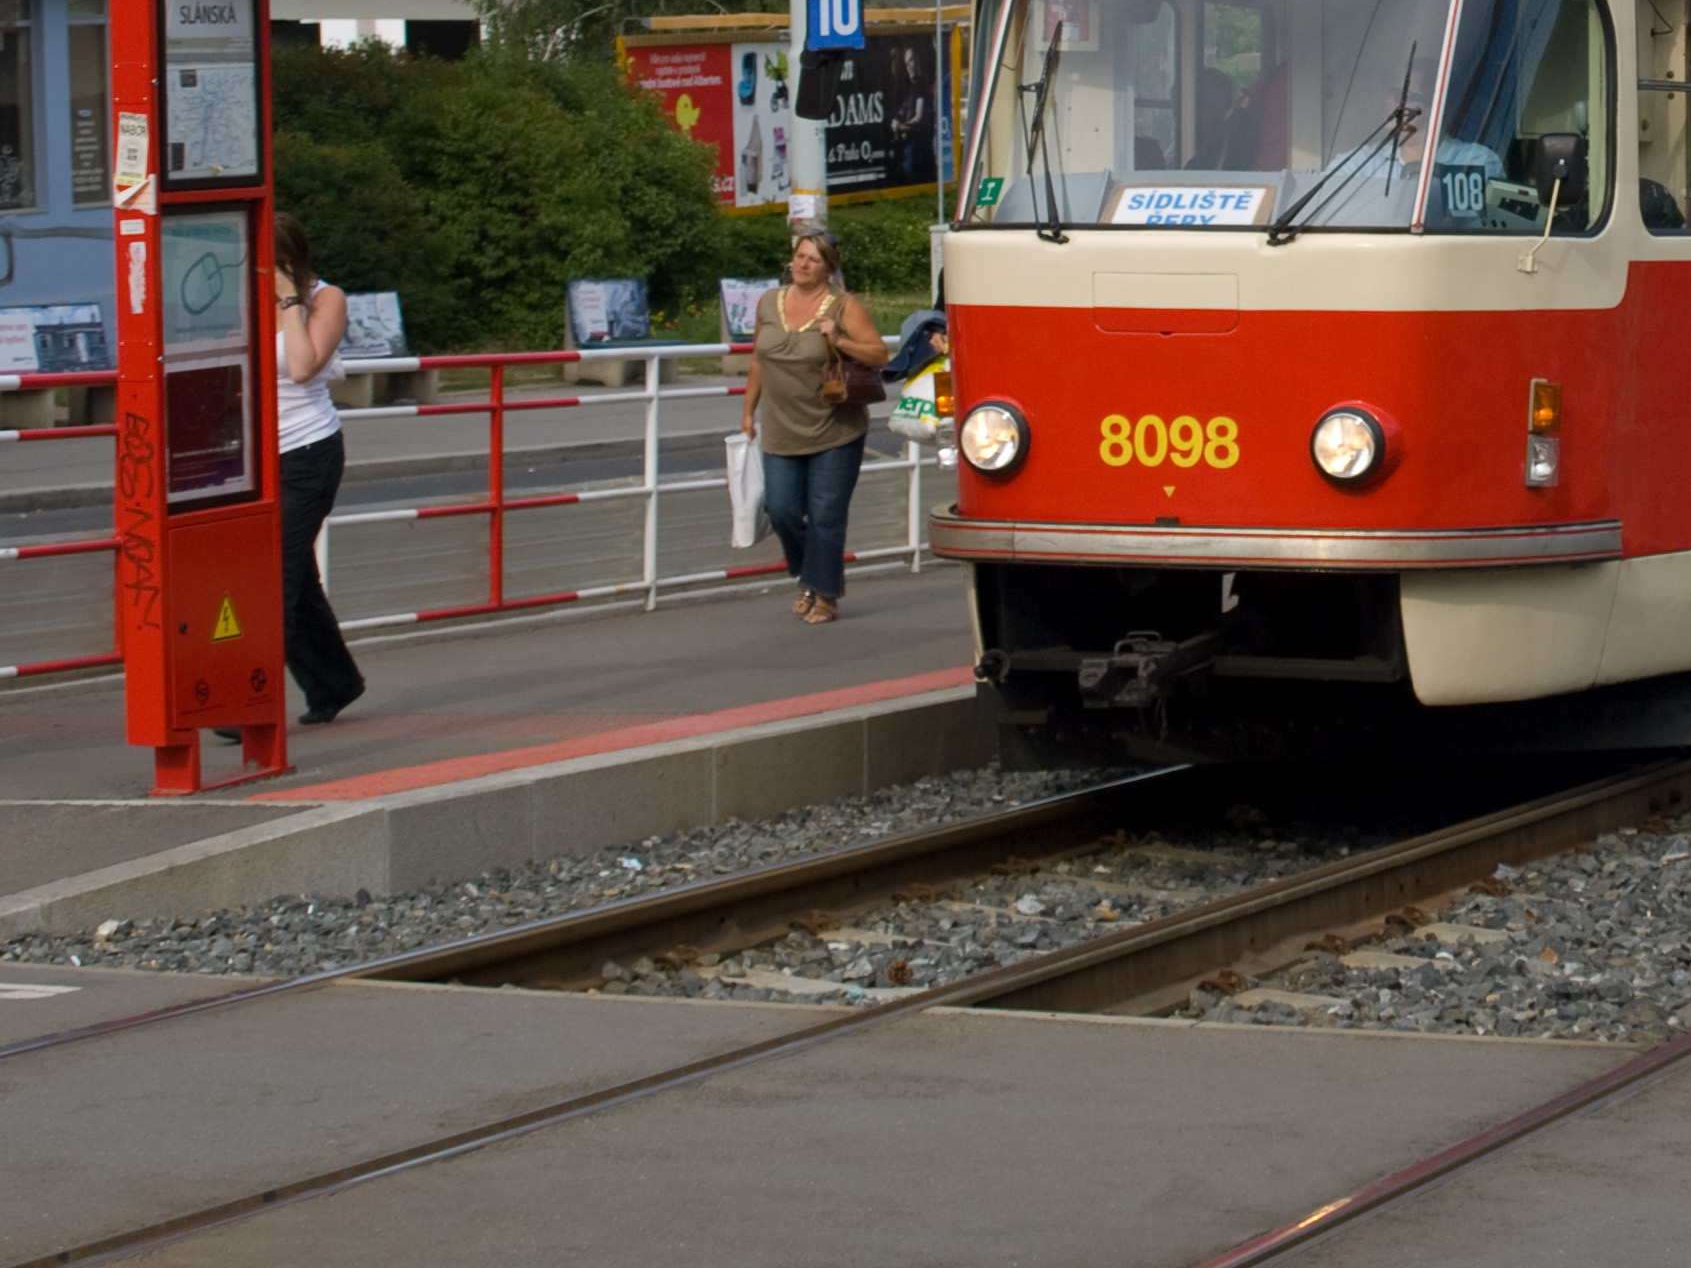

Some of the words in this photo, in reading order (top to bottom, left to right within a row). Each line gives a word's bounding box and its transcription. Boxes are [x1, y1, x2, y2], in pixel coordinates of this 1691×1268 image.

[179, 0, 238, 25] SLÁNSKÁ
[826, 90, 884, 128] DAMS
[1127, 190, 1253, 210] SÍDLIŠTĚ
[1443, 172, 1484, 211] 108
[1099, 414, 1240, 469] 8098
